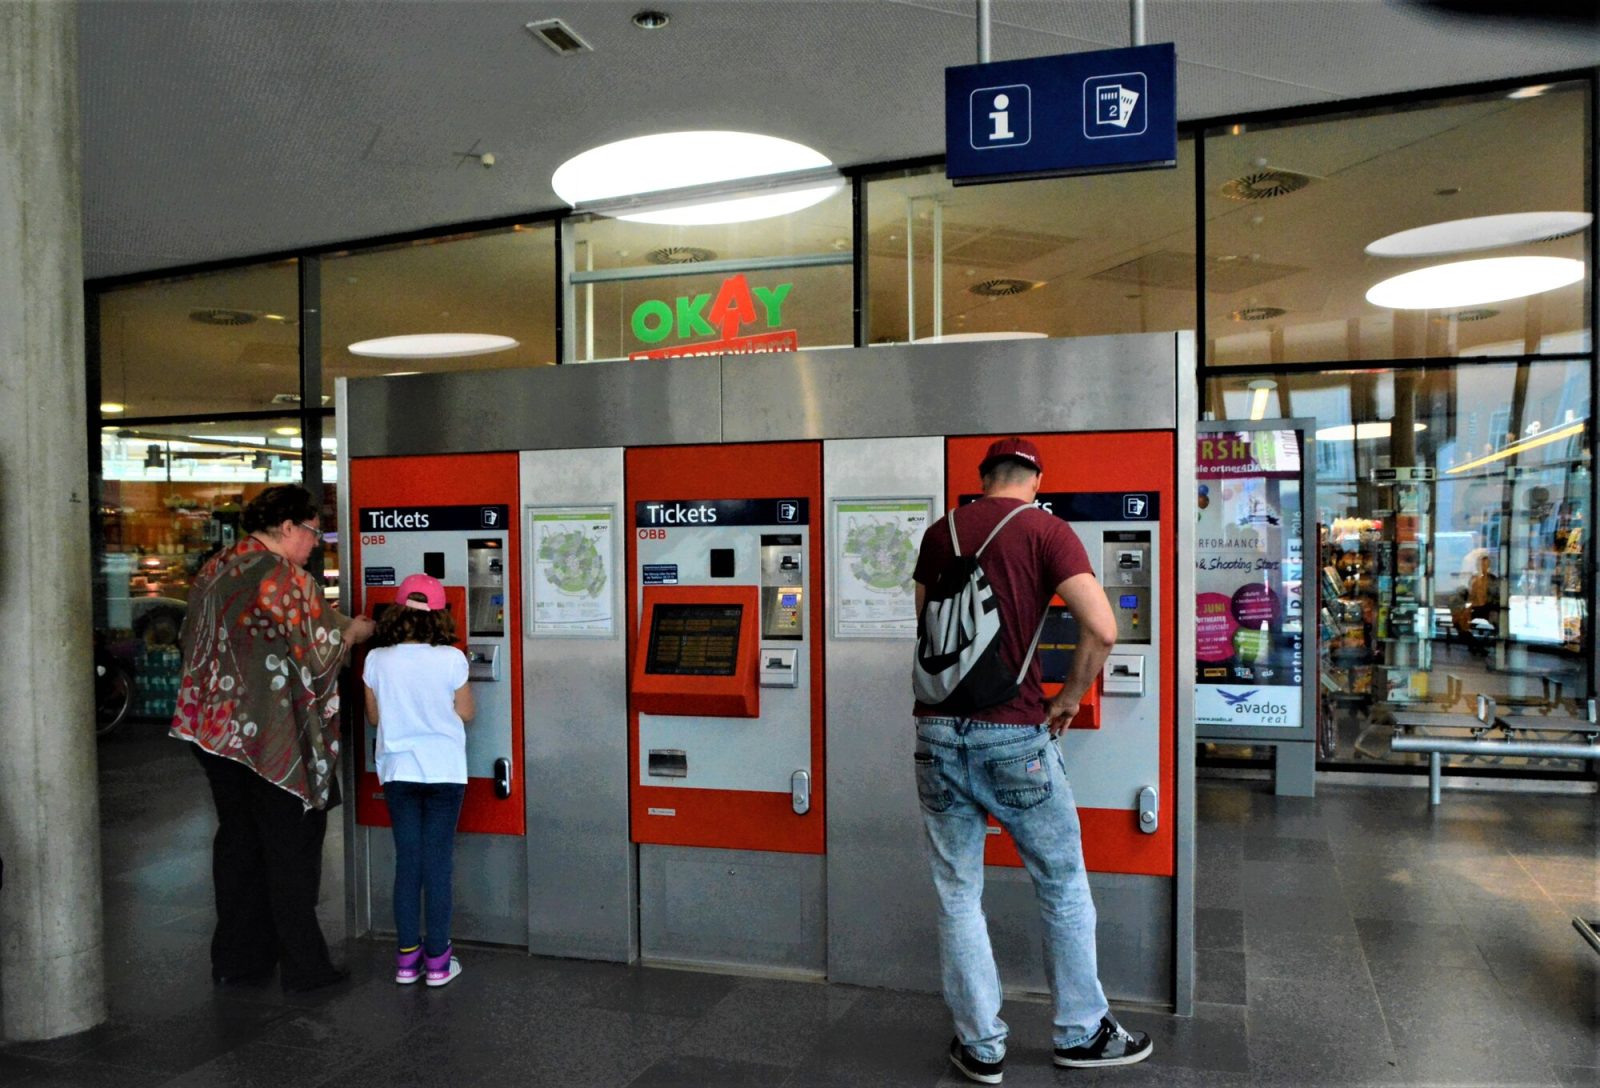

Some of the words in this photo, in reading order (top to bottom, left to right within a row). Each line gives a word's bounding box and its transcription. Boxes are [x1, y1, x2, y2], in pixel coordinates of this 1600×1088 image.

[631, 273, 793, 343] OKAY
[368, 510, 430, 529] Tickets
[647, 503, 717, 523] Tickets
[1207, 556, 1253, 574] Shooting
[923, 566, 1001, 658] NIKE
[1235, 701, 1287, 714] avados
[1260, 716, 1287, 724] real
